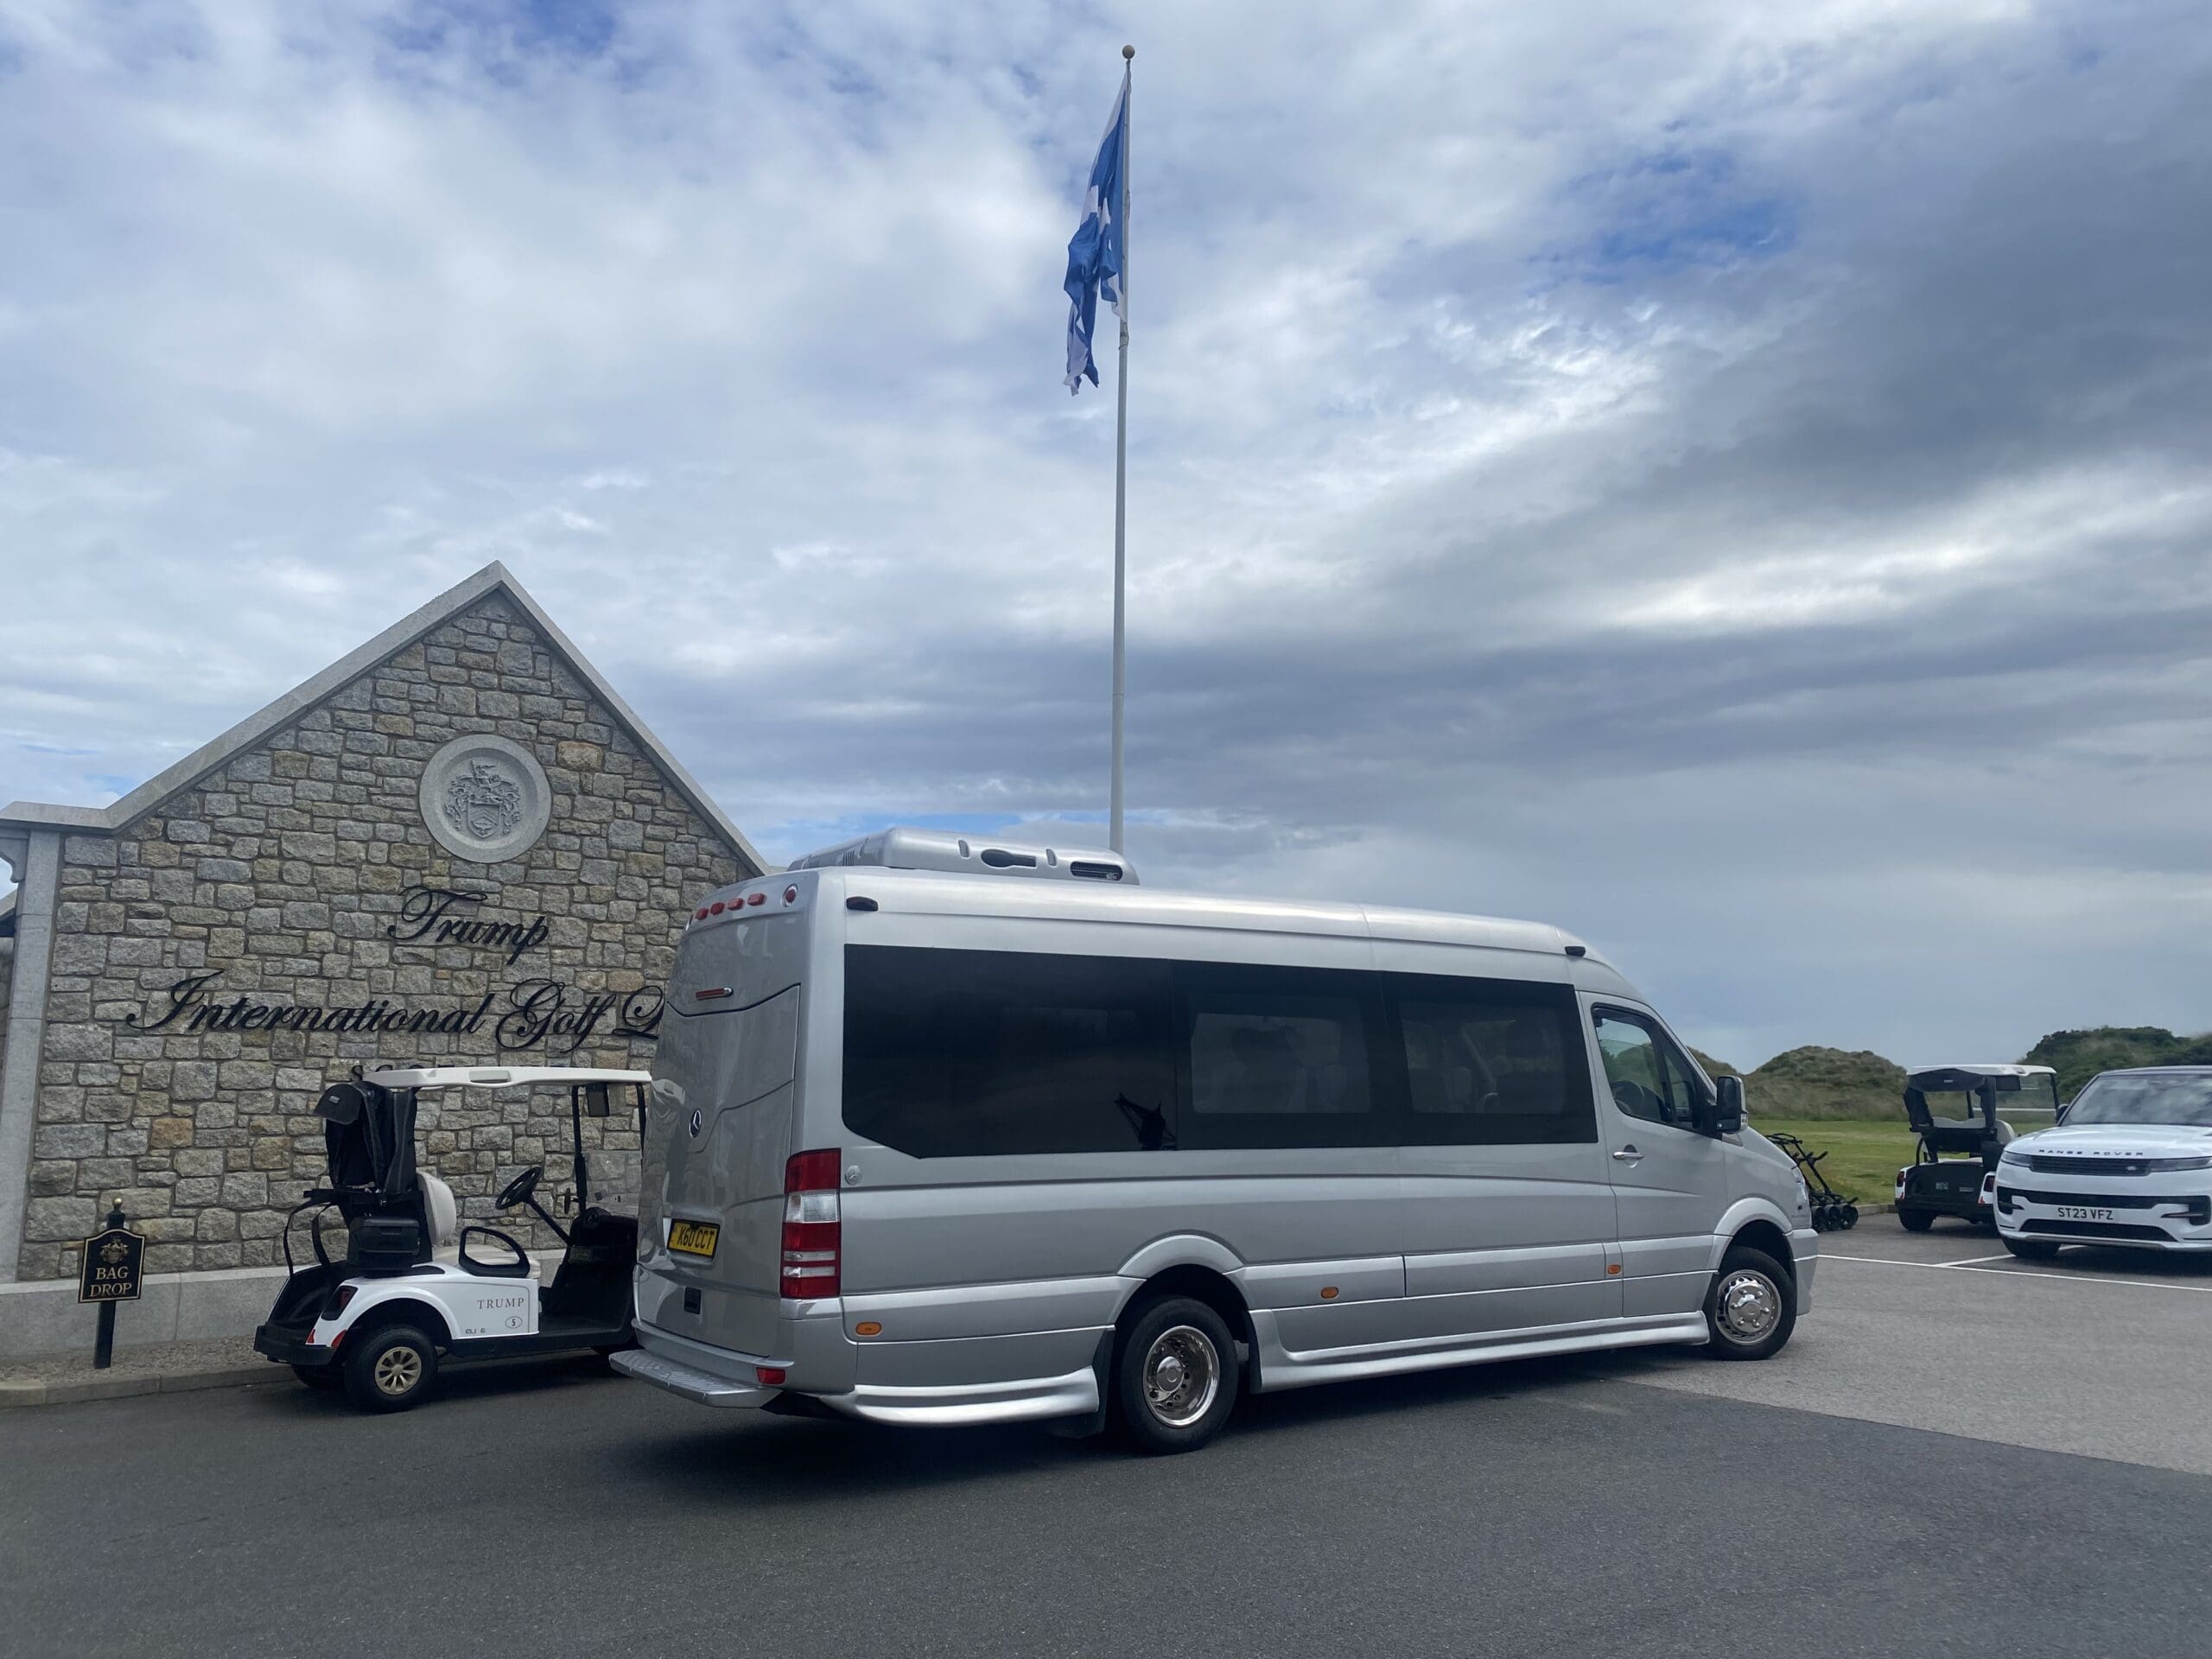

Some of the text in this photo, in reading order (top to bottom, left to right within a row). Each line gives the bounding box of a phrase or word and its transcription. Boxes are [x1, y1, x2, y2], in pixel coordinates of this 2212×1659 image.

[387, 885, 549, 965] Trump
[126, 968, 495, 1033] International
[495, 978, 617, 1053] Golf
[2057, 1207, 2113, 1220] ST23 VFZ
[695, 1229, 715, 1250] CCT
[95, 1266, 130, 1281] BAG
[89, 1282, 132, 1297] DROP
[477, 1297, 524, 1310] TRUMP
[511, 1318, 517, 1327] 5
